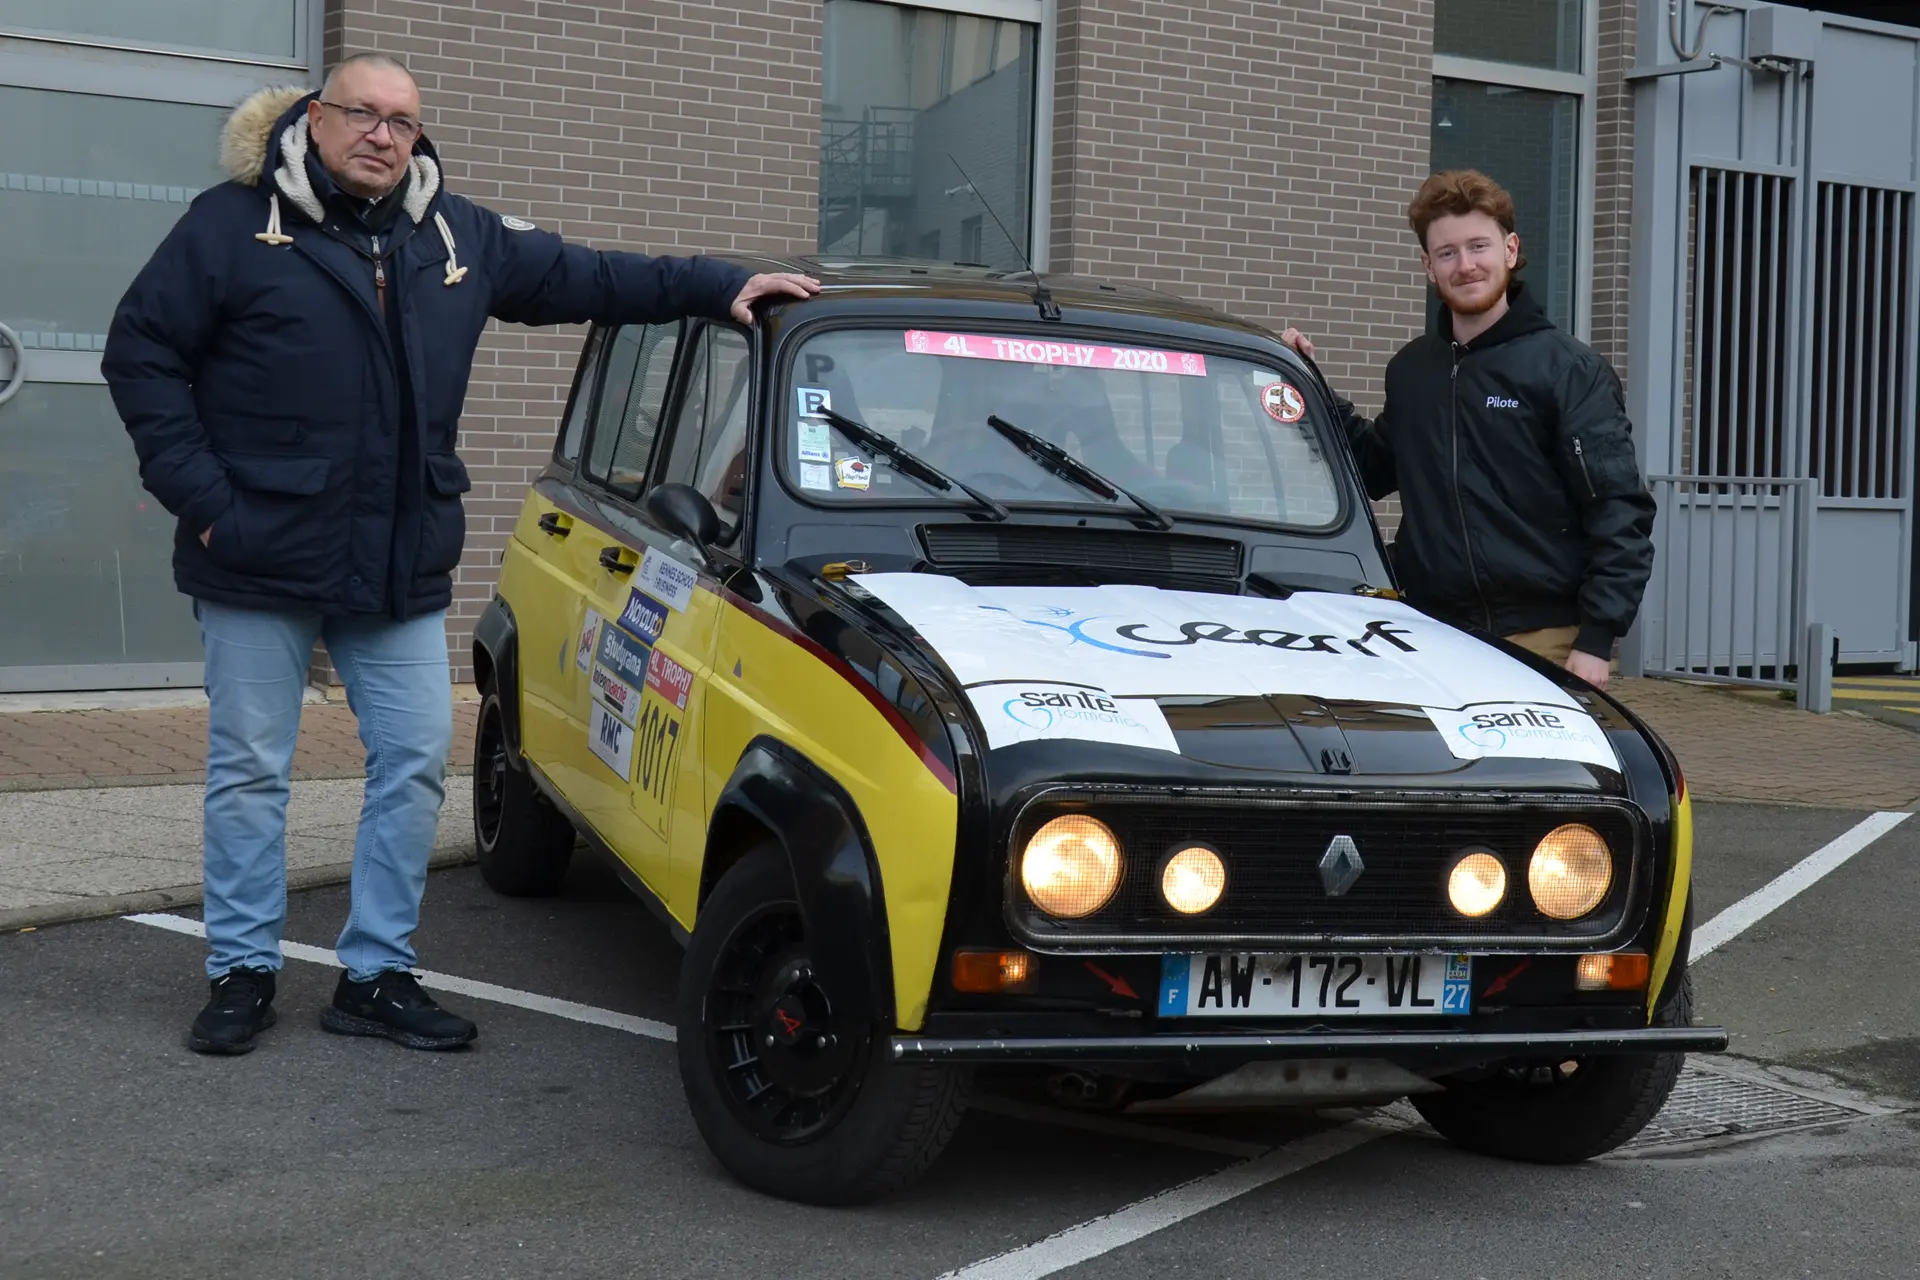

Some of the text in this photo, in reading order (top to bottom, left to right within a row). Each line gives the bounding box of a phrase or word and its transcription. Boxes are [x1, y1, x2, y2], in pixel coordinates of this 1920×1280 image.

[943, 335, 1169, 371] 4L TROPHY 2020
[1486, 396, 1519, 408] Pilote
[624, 596, 663, 637] Norauto
[661, 657, 692, 692] TROPHY
[600, 711, 622, 755] RMC
[635, 699, 680, 806] 1017
[1168, 989, 1179, 1004] F
[1444, 984, 1469, 1009] 27
